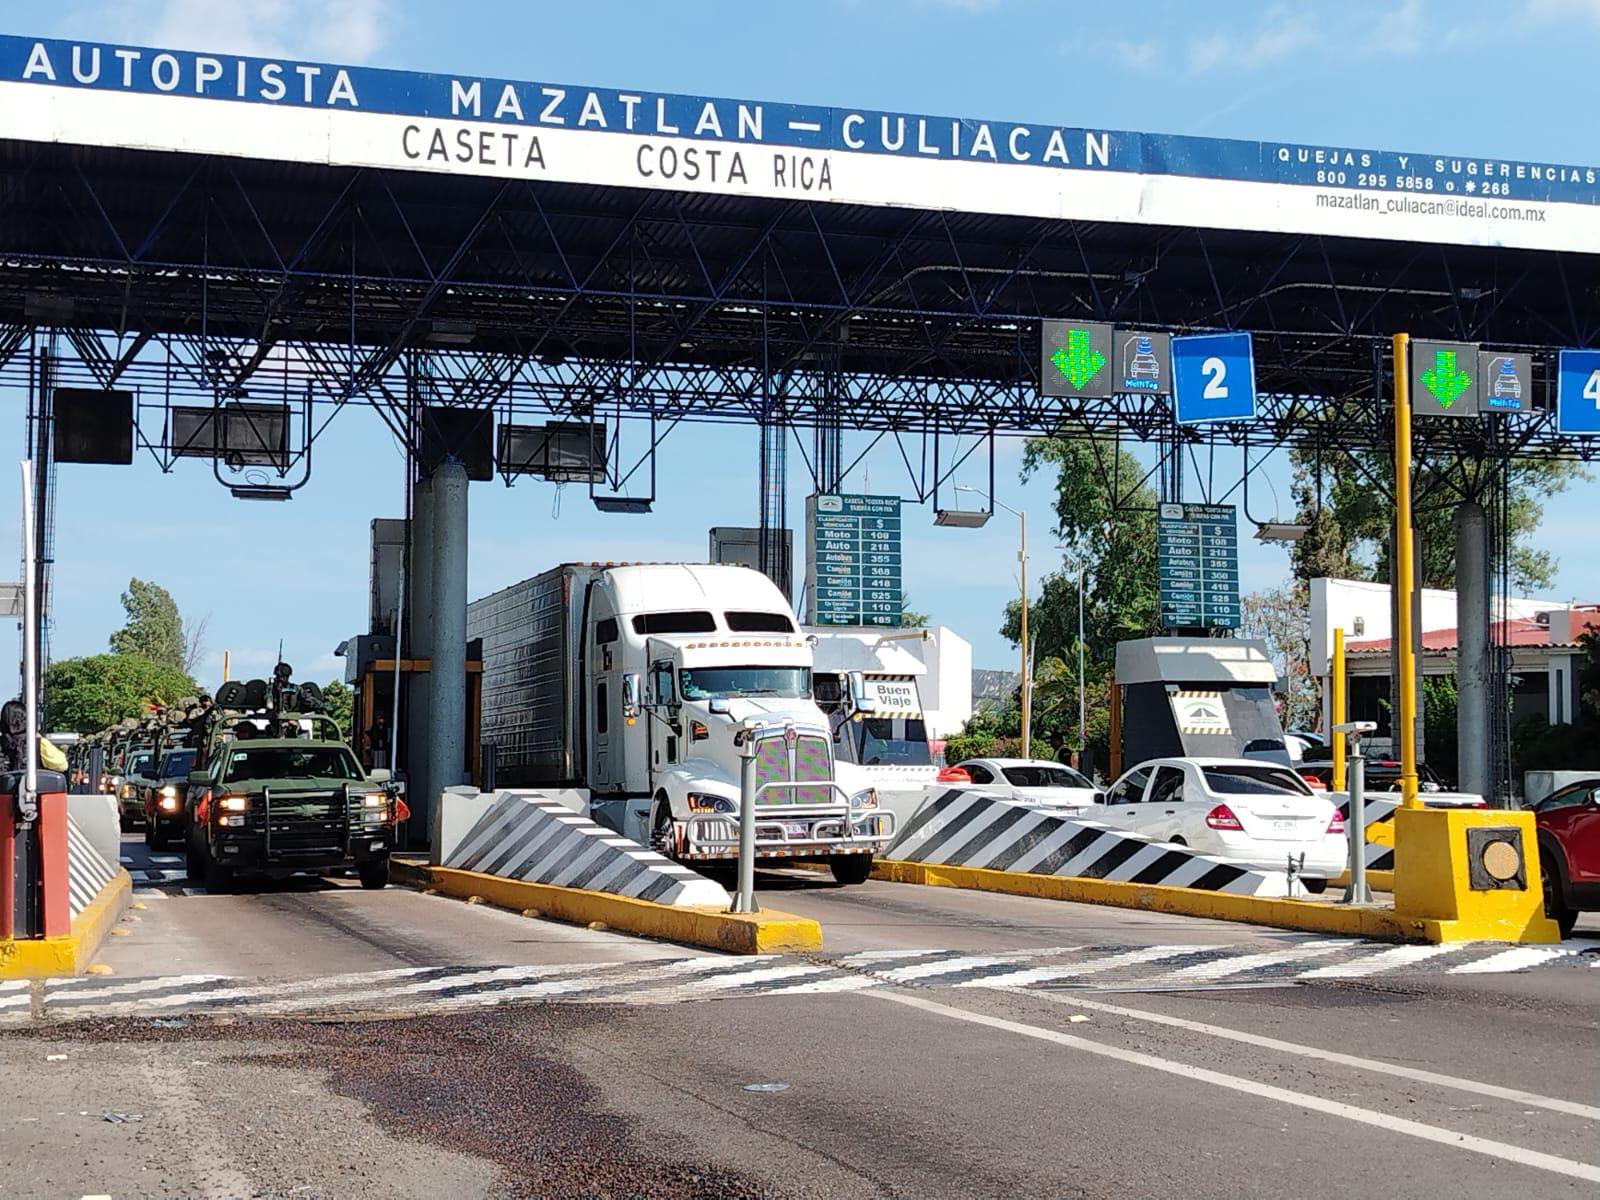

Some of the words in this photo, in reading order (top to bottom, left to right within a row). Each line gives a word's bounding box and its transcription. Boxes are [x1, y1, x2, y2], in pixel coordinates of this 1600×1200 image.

[22, 42, 359, 107] AUTOPISTA
[450, 79, 764, 141] MAZATLAN
[841, 113, 1110, 168] CULIACAN
[403, 125, 547, 170] CASETA
[637, 143, 748, 186] COSTA
[773, 154, 833, 192] RICA
[1278, 148, 1371, 167] QUEJAS
[1399, 156, 1409, 170] Y
[1435, 159, 1596, 184] SUGERENCIAS
[1316, 170, 1346, 185] 800
[1358, 173, 1387, 188] 295
[1395, 176, 1434, 191] 5858
[1316, 192, 1546, 222] mazatlan_culiacan@ideal.com.mx
[1201, 356, 1229, 400] 2
[876, 519, 884, 529] $
[824, 530, 851, 538] Moto
[1214, 526, 1222, 536] $
[825, 541, 850, 550] Auto
[870, 543, 889, 551] 218
[1168, 547, 1192, 555] Auto
[871, 555, 890, 563] 355
[877, 685, 910, 695] Buen
[879, 696, 912, 708] Viaje
